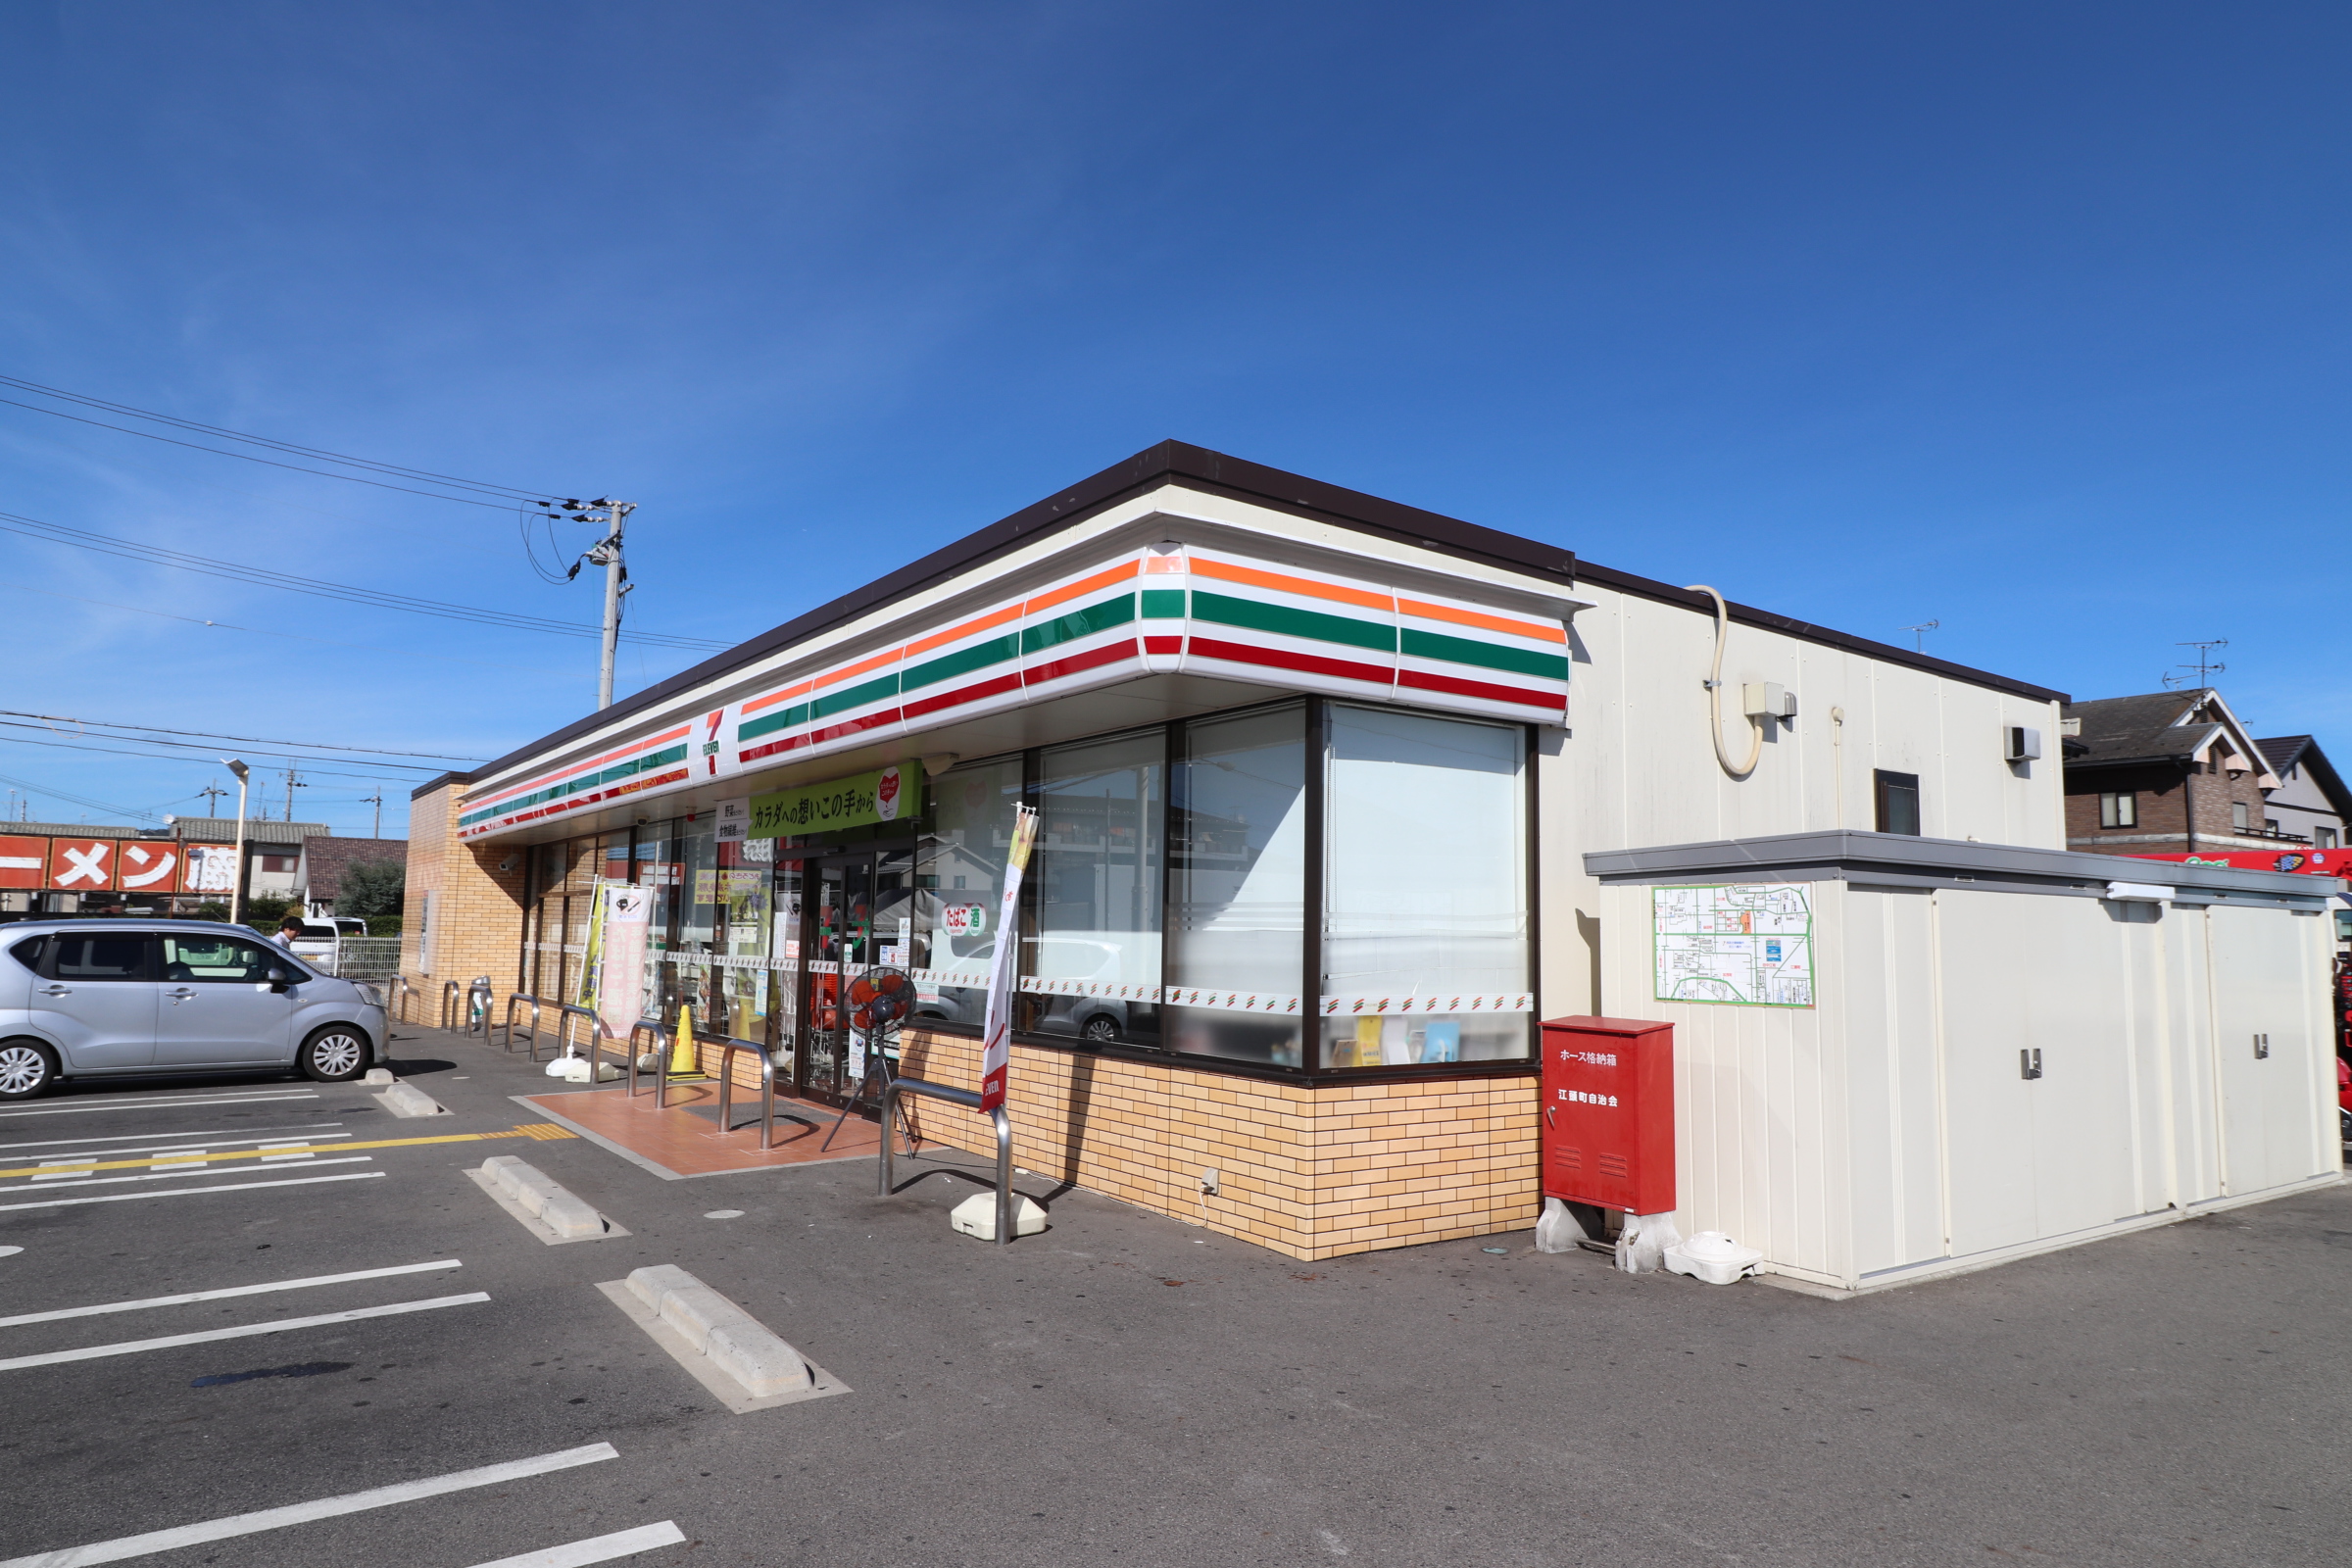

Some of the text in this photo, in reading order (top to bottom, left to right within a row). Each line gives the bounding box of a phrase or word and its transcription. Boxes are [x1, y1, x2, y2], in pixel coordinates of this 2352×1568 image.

[706, 708, 724, 776] 7
[754, 788, 874, 829] カラダへの想いこの手から
[946, 907, 966, 927] たばこ
[969, 907, 980, 928] 酒
[1559, 1049, 1617, 1067] ホース格納箱
[1558, 1088, 1618, 1107] 江頭町自治会
